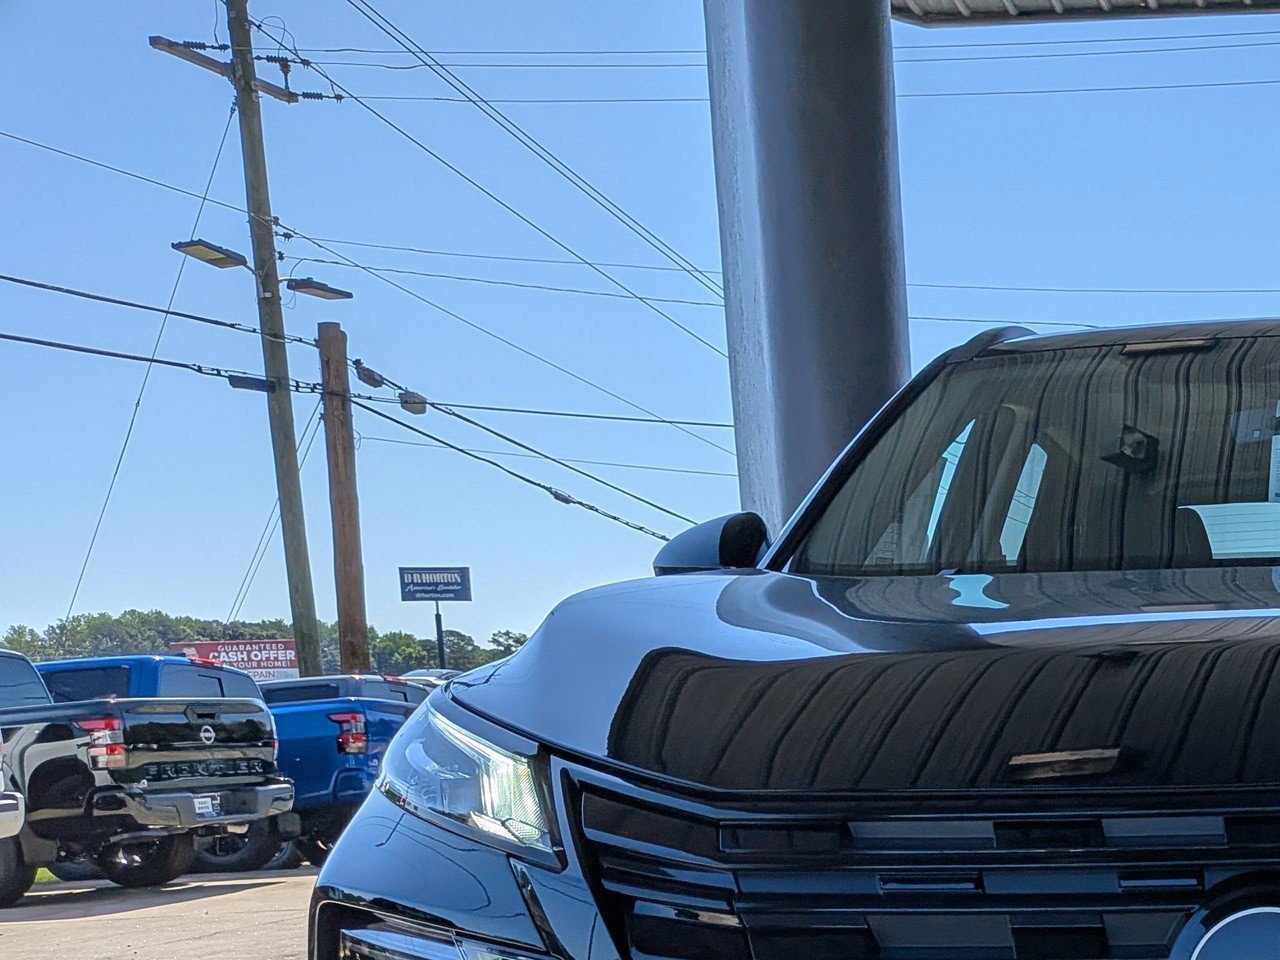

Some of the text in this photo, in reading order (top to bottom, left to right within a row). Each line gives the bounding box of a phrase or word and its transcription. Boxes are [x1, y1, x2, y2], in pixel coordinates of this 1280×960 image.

[217, 643, 285, 652] GUARANTEED
[209, 650, 296, 661] CASH OFFER
